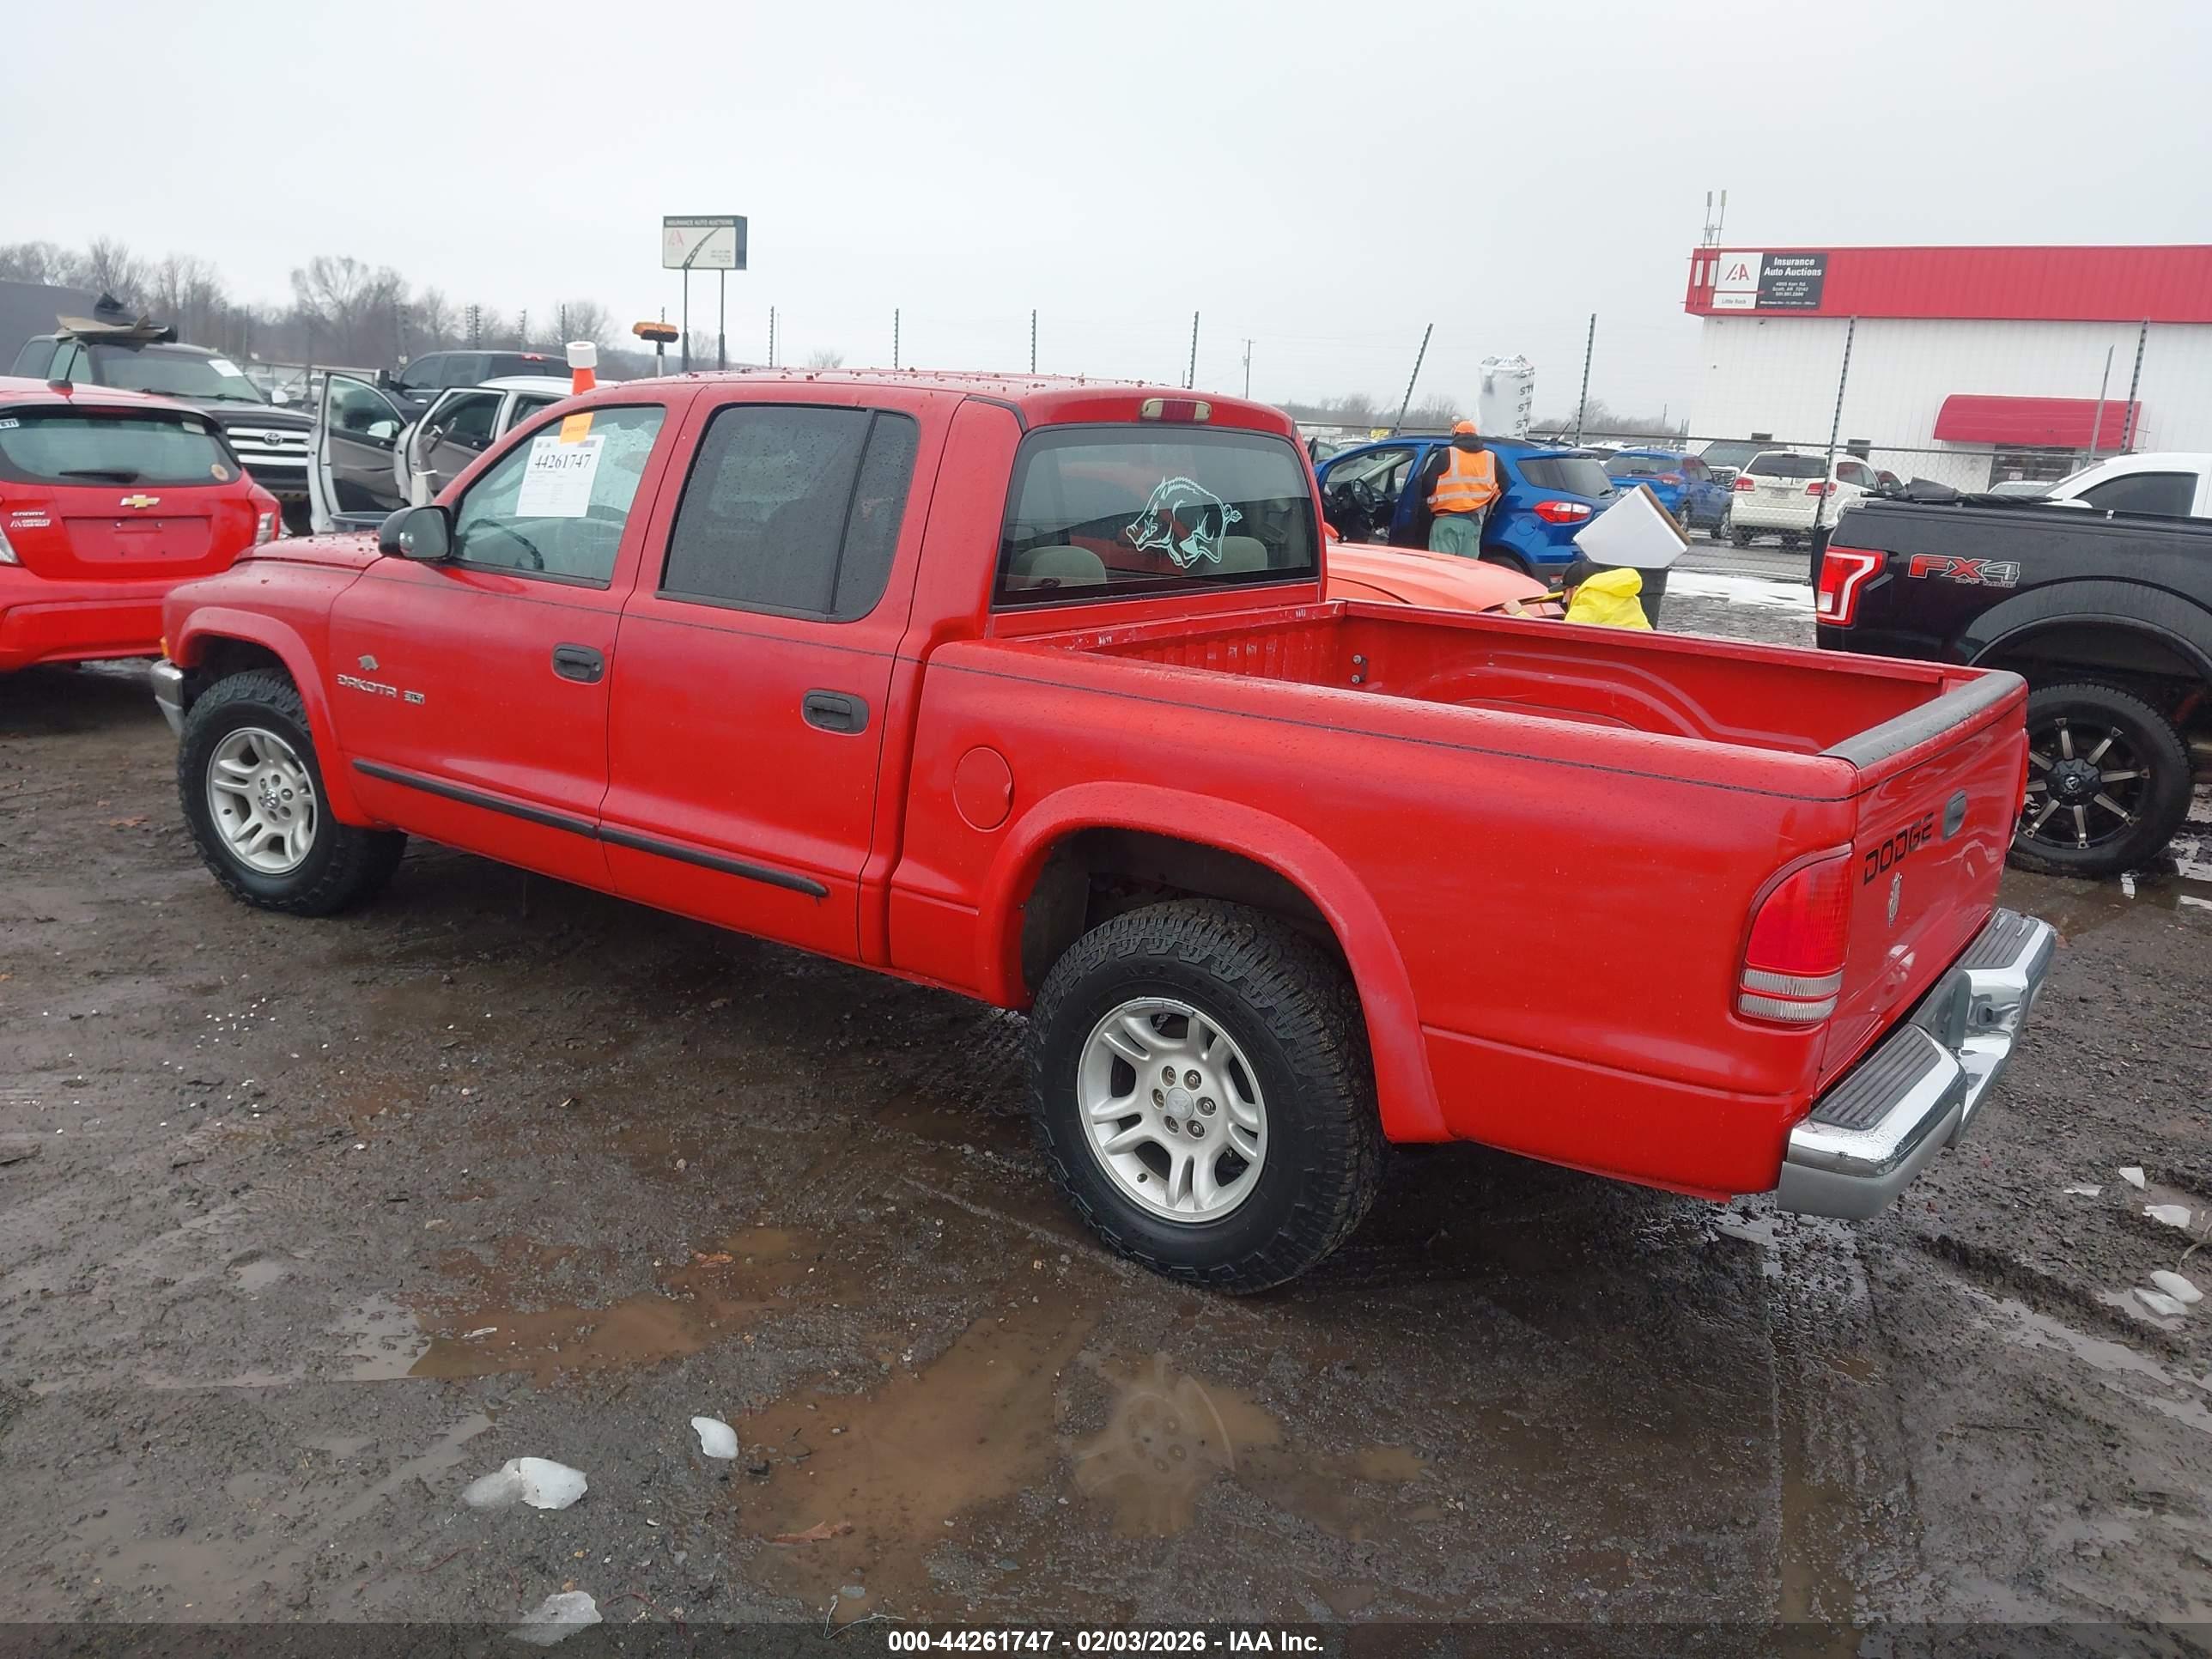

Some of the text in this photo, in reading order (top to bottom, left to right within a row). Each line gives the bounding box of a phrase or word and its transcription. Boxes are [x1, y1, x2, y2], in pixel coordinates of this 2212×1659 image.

[1764, 267, 1822, 276] Auto Auctions
[1774, 257, 1815, 266] Insurance
[534, 453, 592, 469] 44261747
[1908, 553, 2021, 584] FX4
[337, 673, 398, 698] DAKOTA
[1863, 811, 1935, 886] DODGE
